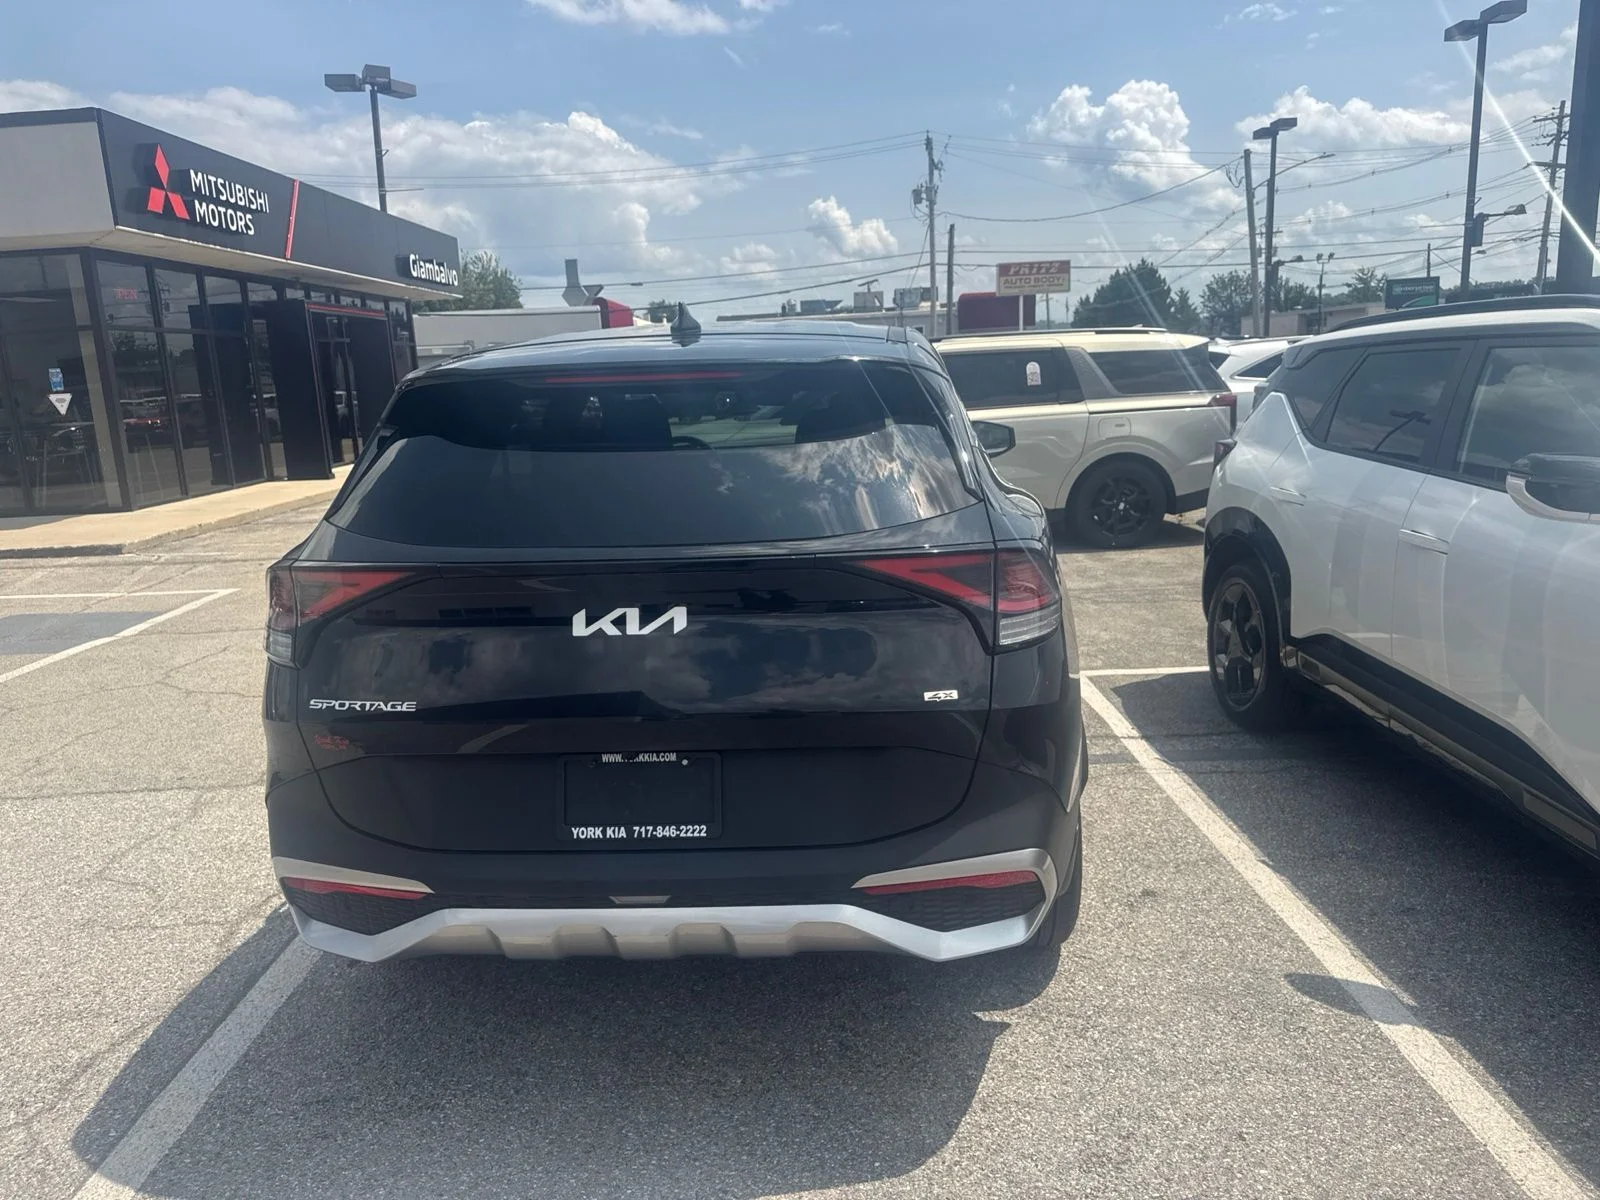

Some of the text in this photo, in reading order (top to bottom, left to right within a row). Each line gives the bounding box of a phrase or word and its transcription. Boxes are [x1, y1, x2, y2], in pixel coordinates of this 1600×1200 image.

[189, 168, 270, 214] MITSUBISHI
[194, 199, 255, 236] MOTORS
[409, 253, 459, 287] Giambalvo
[1003, 276, 1031, 286] AUTO
[1034, 275, 1062, 284] BODY
[572, 606, 687, 637] KIA
[309, 698, 417, 712] SPORTAGE
[601, 751, 677, 763] WWW.KKIA.COM
[571, 824, 707, 839] YORK KIA 717-846-2222
